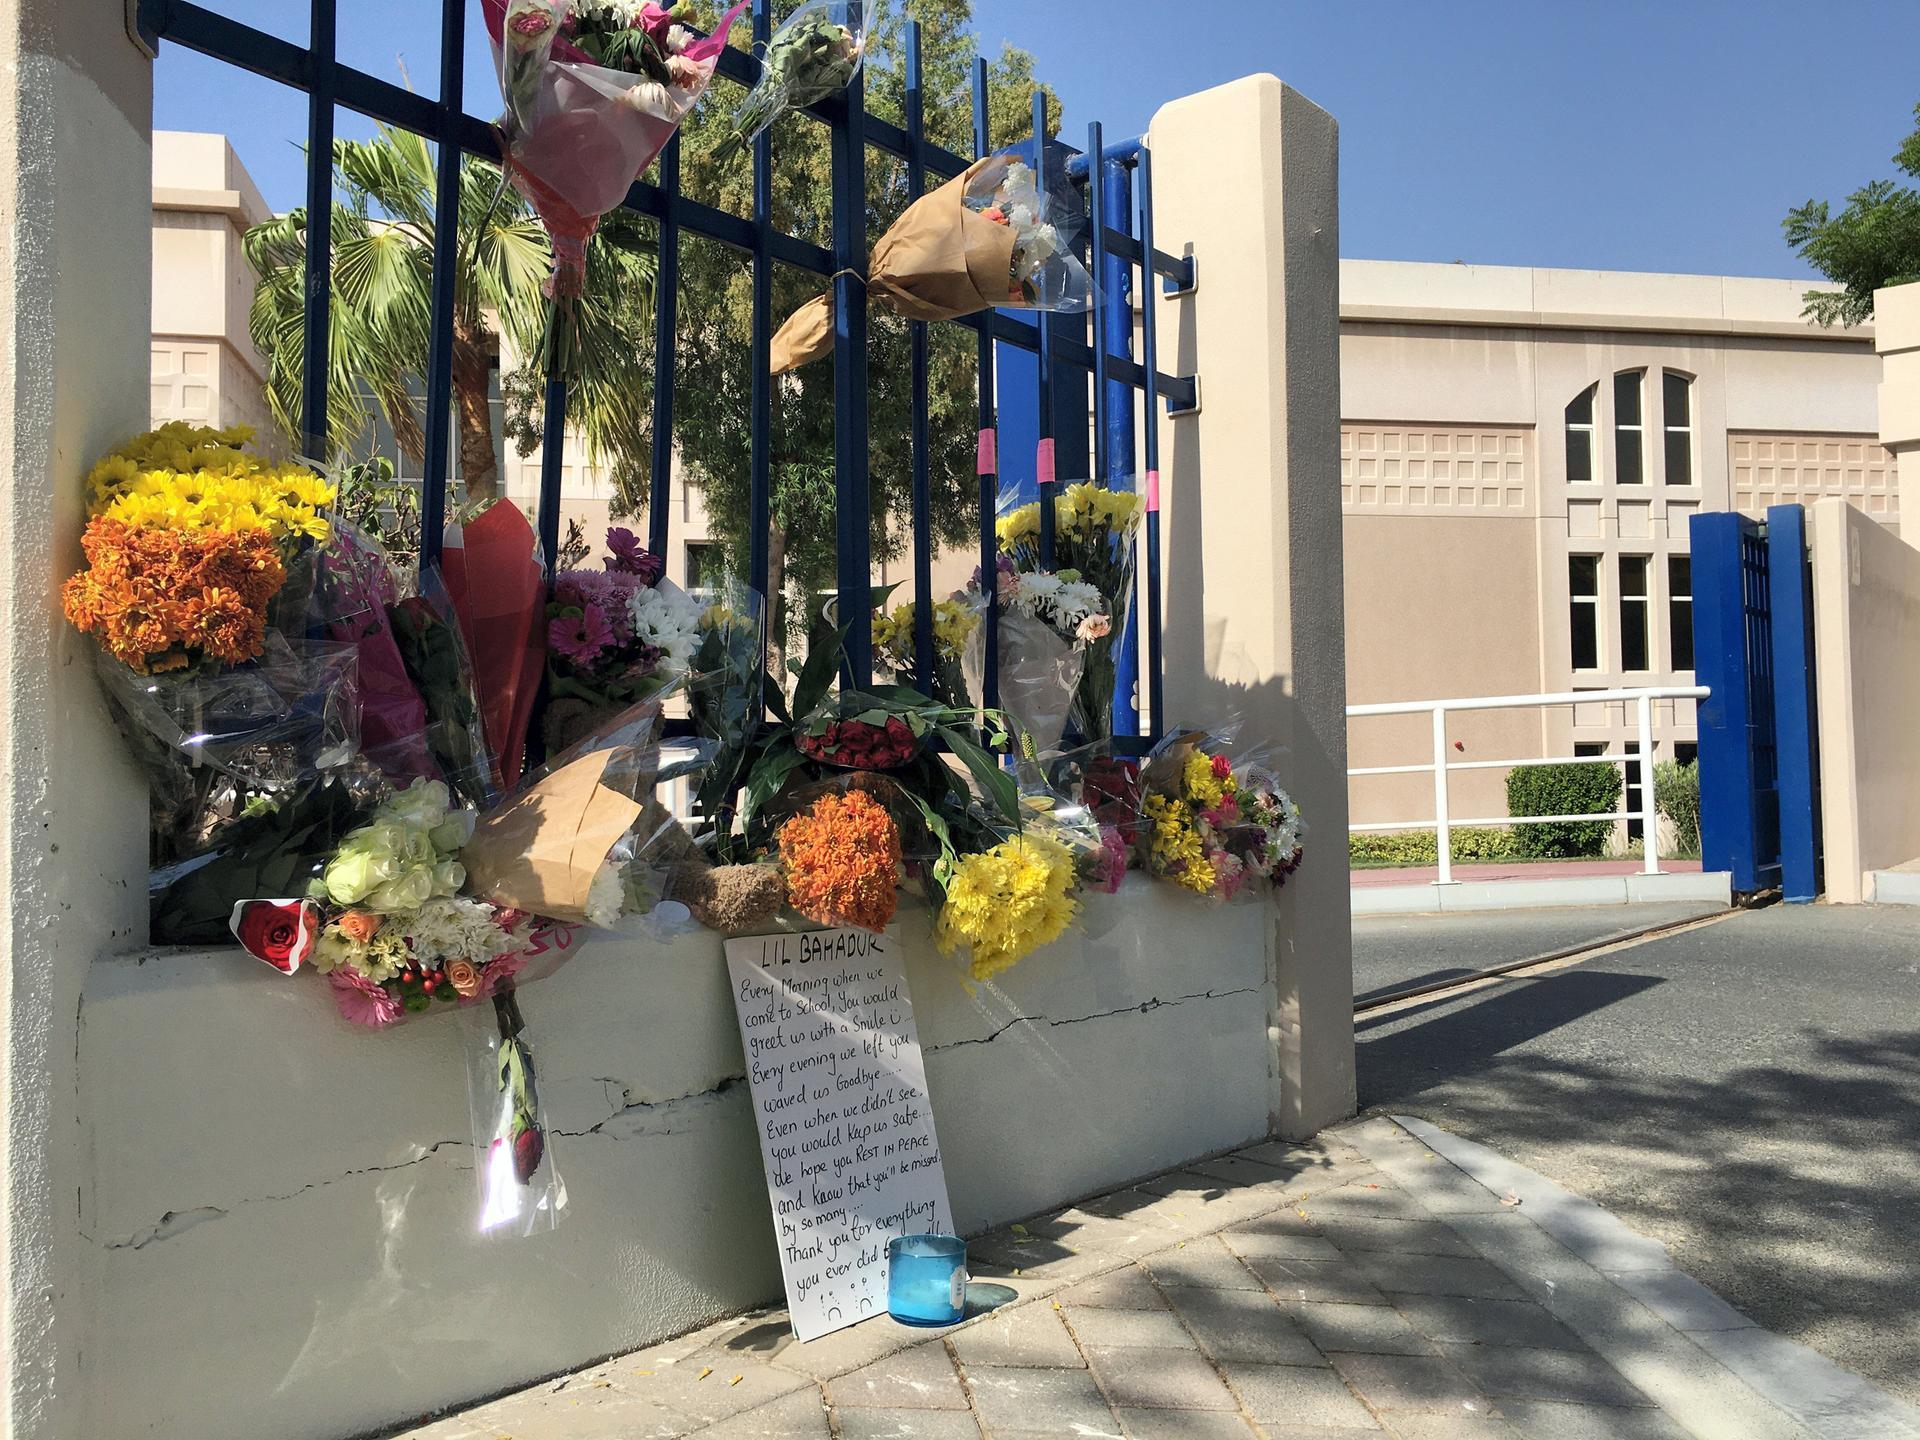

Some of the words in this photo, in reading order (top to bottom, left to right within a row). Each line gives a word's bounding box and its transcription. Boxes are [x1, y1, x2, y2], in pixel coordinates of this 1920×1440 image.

[762, 938, 790, 968] LIL
[800, 932, 884, 964] BAHADUR
[741, 978, 774, 1013] Every
[781, 977, 829, 996] Morning
[833, 969, 860, 987] when
[867, 967, 883, 979] we
[745, 1009, 776, 1027] come
[779, 1003, 792, 1021] to
[864, 984, 899, 1005] would
[751, 1026, 786, 1058] greet
[790, 1031, 806, 1045] us
[811, 1022, 836, 1041] with
[840, 1024, 848, 1033] a
[752, 1061, 784, 1092] Every
[789, 1053, 836, 1076] evening
[840, 1048, 857, 1061] we
[864, 1034, 884, 1058] left
[890, 1034, 909, 1059] you
[764, 1084, 807, 1113] waved
[813, 1087, 830, 1100] us
[767, 1120, 797, 1140] Even
[804, 1108, 839, 1130] when
[843, 1106, 858, 1118] we
[861, 1088, 895, 1114] didn't
[801, 1161, 828, 1184] hope
[833, 1157, 853, 1178] you
[856, 1144, 879, 1162] REST
[884, 1143, 894, 1157] IN
[898, 1134, 929, 1152] PEACE
[802, 1127, 842, 1153] would
[874, 1121, 888, 1133] us
[778, 1190, 806, 1215] and
[848, 1175, 871, 1196] that
[873, 1166, 896, 1192] you'll
[900, 1160, 909, 1173] be
[782, 1217, 797, 1245] by
[801, 1218, 813, 1232] so
[786, 1237, 823, 1265] Thank
[827, 1233, 850, 1263] you
[851, 1215, 872, 1248] for
[876, 1199, 936, 1236] everything
[797, 1275, 820, 1302] you
[826, 1262, 852, 1279] ever
[857, 1245, 878, 1269] did
